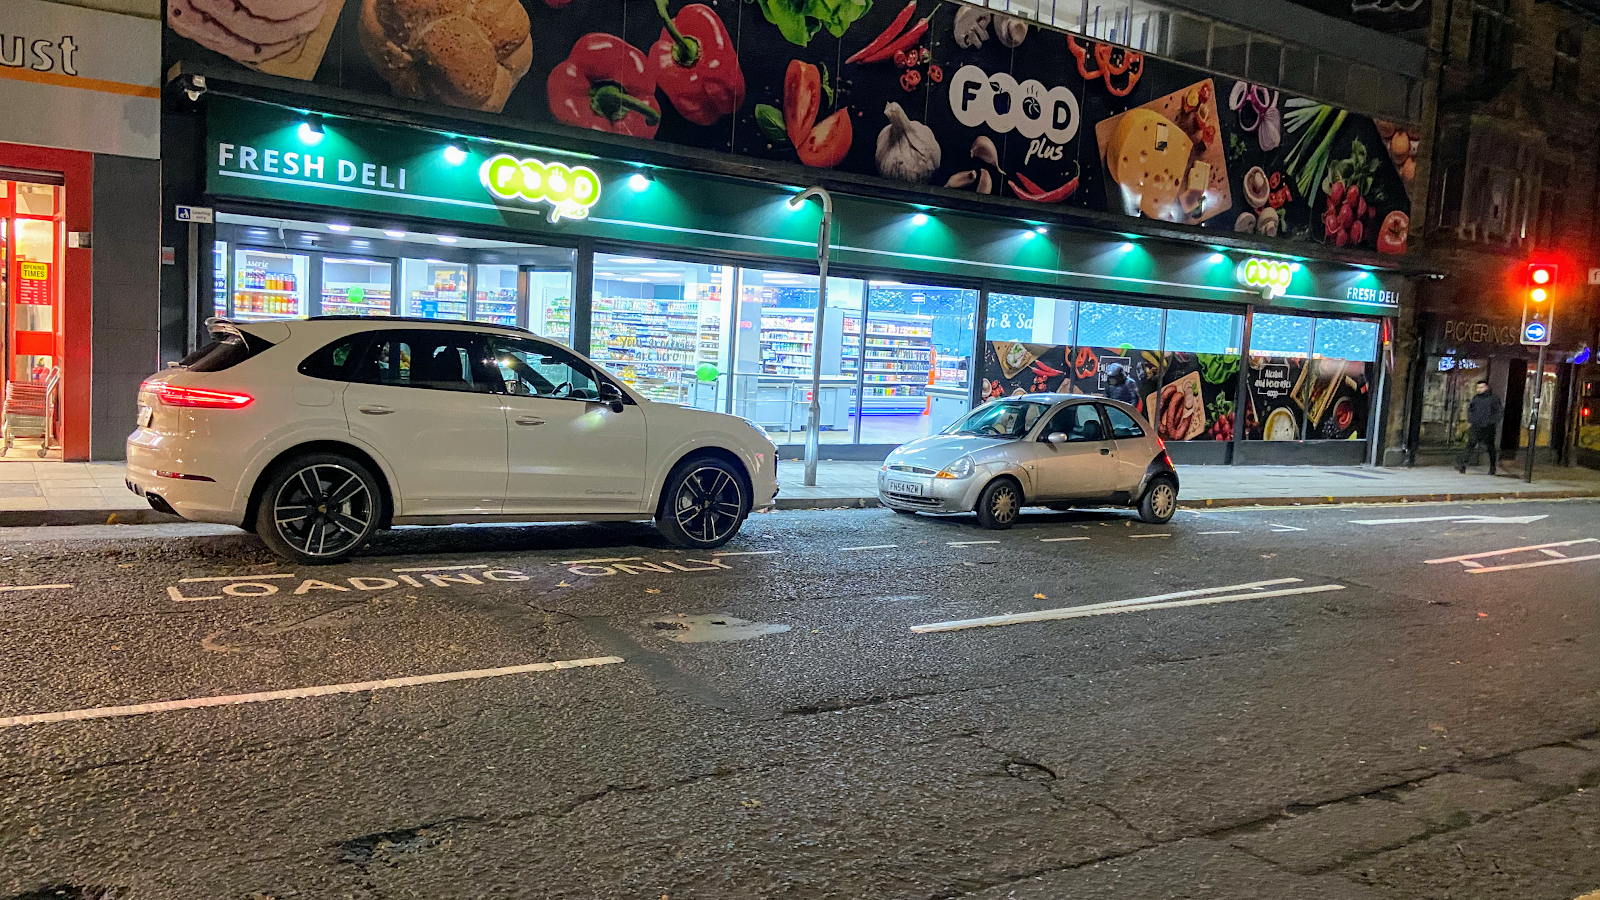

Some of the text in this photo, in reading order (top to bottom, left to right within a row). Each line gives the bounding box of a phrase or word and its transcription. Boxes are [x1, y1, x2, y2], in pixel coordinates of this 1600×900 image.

[958, 79, 1073, 132] FOOD
[1024, 138, 1063, 165] plus
[219, 142, 406, 190] FRESH DELI
[23, 270, 45, 278] TIMES
[1347, 287, 1400, 305] FRESH DELI
[1444, 320, 1516, 346] PICKERINGS
[1254, 379, 1291, 389] and beverages
[1264, 369, 1283, 379] Alcohol
[889, 481, 905, 492] FN54
[166, 558, 733, 602] LOADING ONLY
